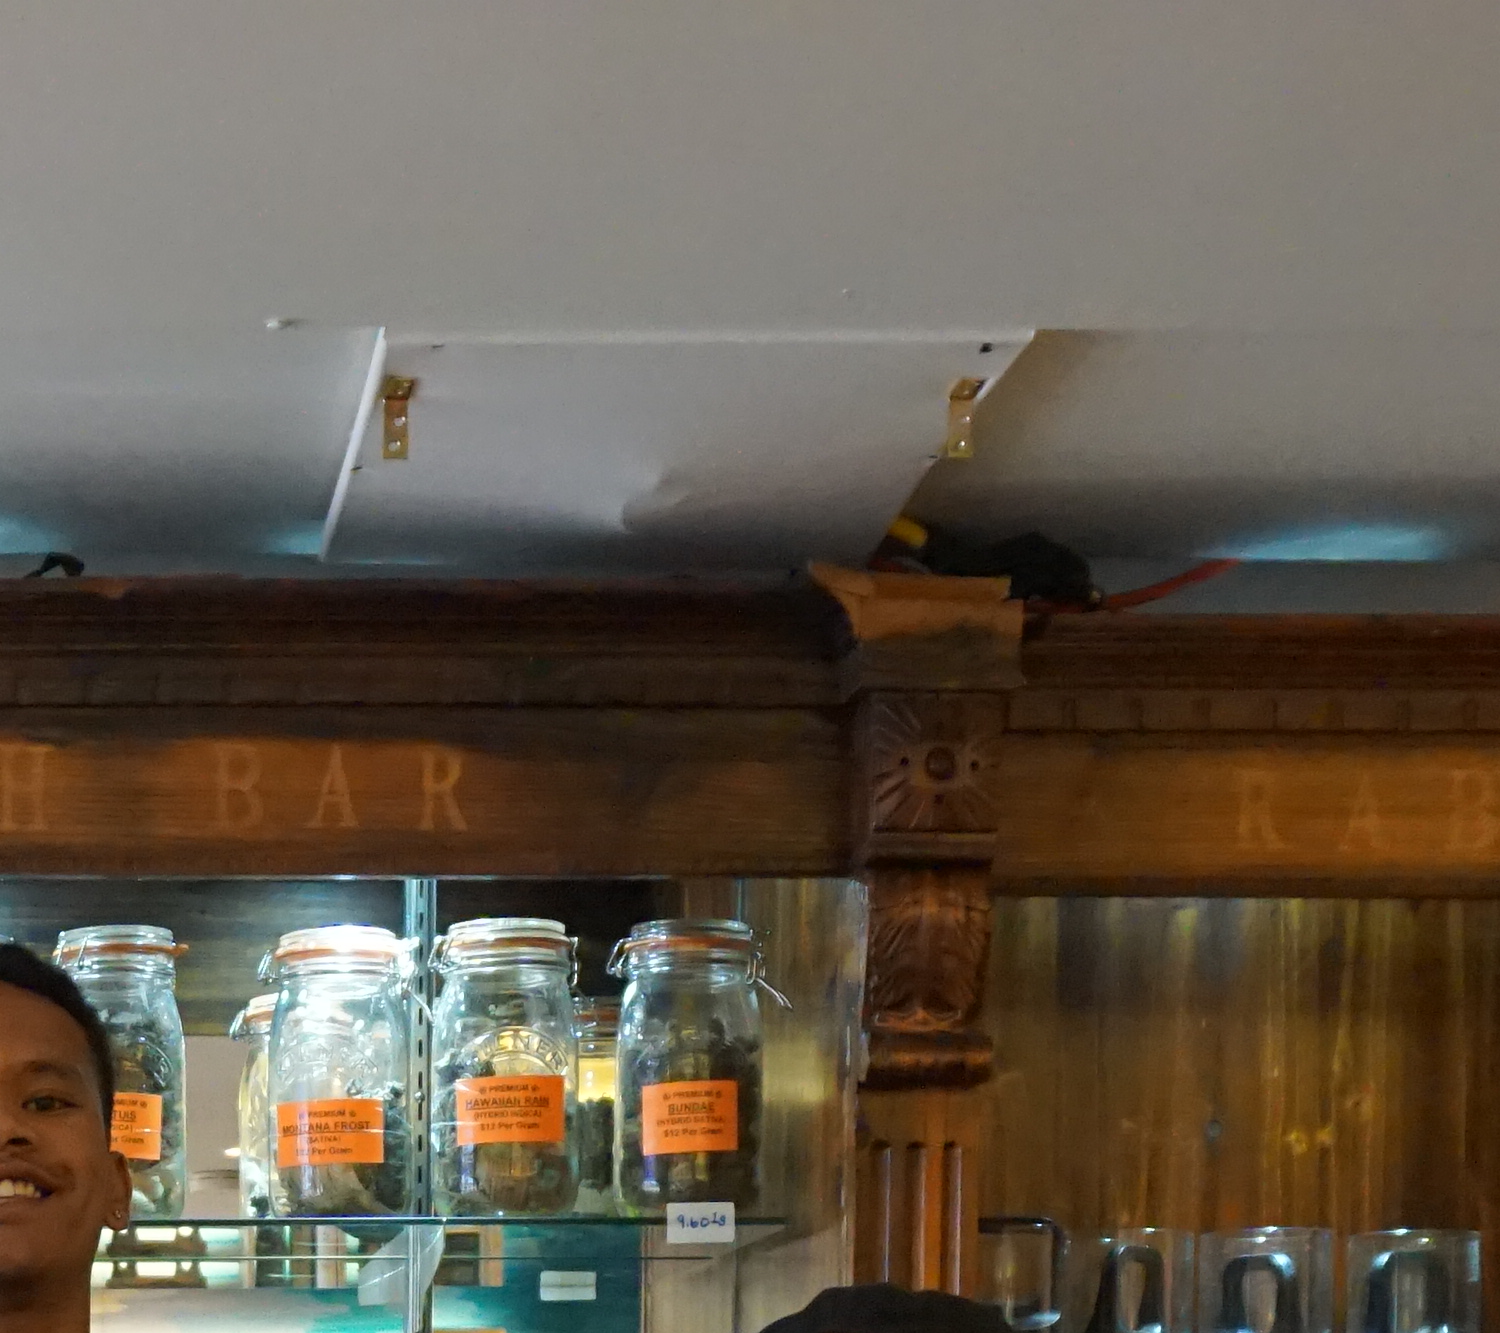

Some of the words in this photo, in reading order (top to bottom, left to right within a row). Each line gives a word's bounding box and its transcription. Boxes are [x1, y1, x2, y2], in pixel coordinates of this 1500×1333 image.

[212, 740, 468, 832] BAR
[488, 1083, 530, 1094] PREMIUM
[281, 1121, 331, 1136] MONTANA
[333, 1119, 372, 1132] FROST
